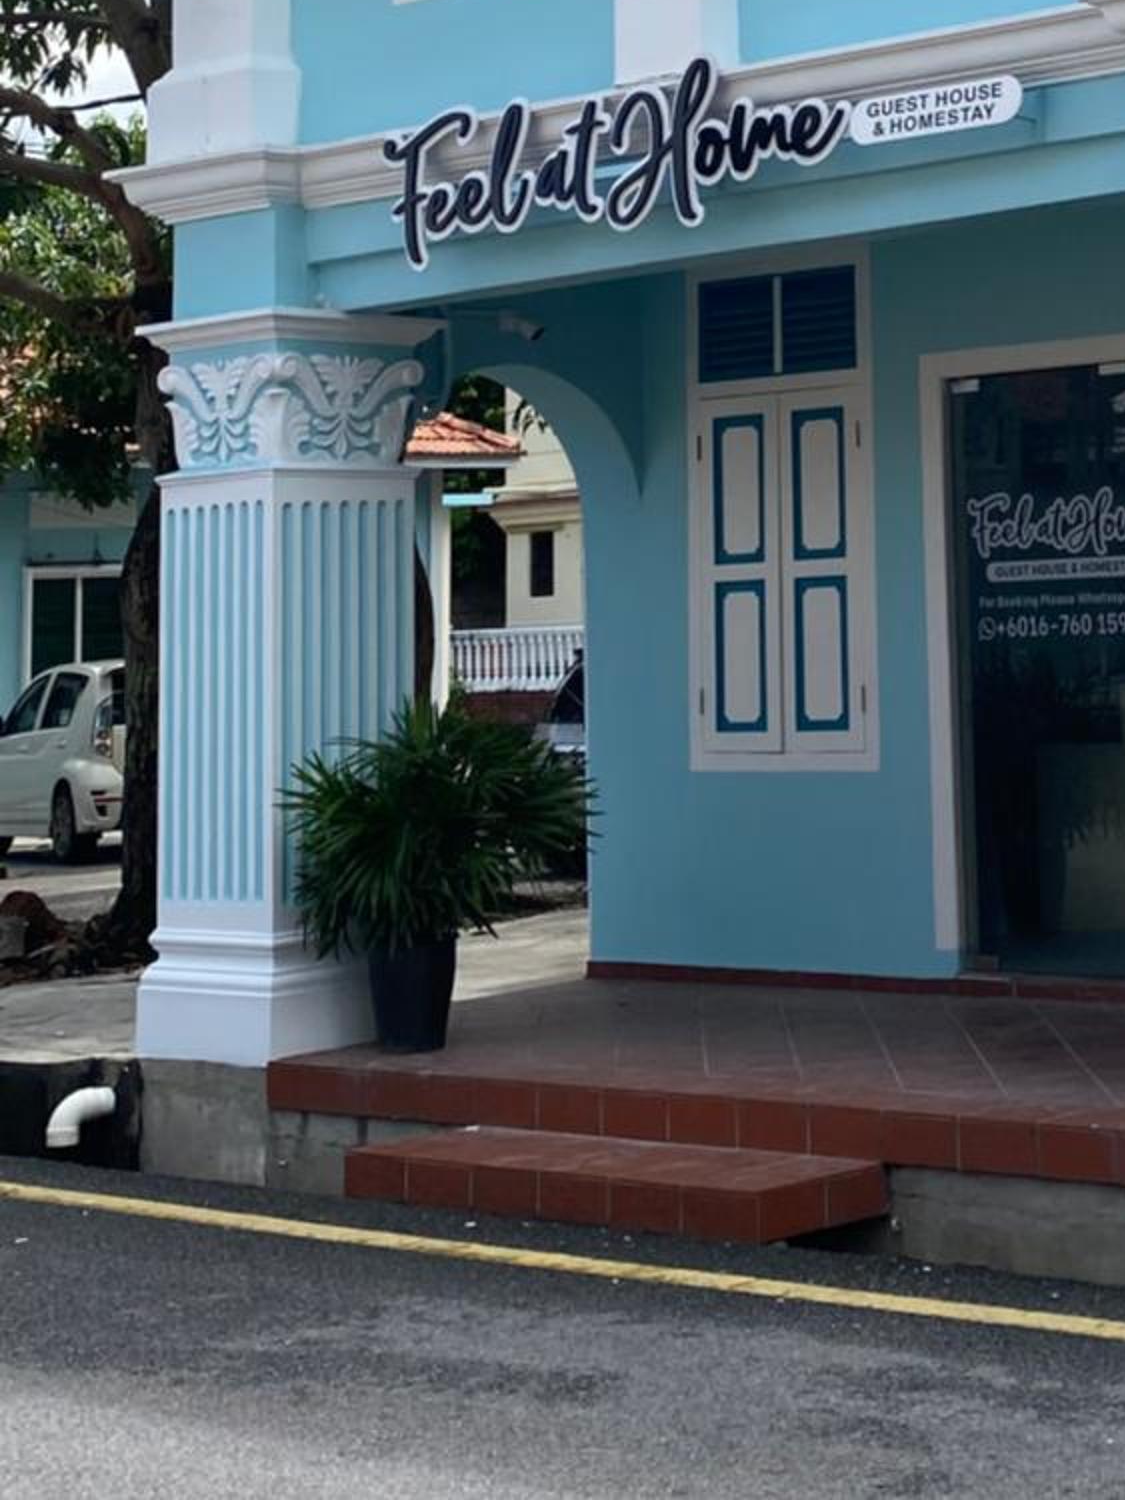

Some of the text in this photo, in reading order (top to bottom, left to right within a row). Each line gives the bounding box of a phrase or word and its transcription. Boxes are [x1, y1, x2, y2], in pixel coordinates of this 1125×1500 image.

[866, 82, 1002, 118] GUEST HOUSE
[873, 103, 995, 136] & HOMESTAY
[384, 58, 844, 265] Feel at Home
[967, 492, 1034, 558] Feel
[1031, 498, 1065, 550] at
[994, 563, 1028, 578] GUEST
[1031, 562, 1068, 576] HOUSE
[998, 614, 1092, 637] +6016-760
